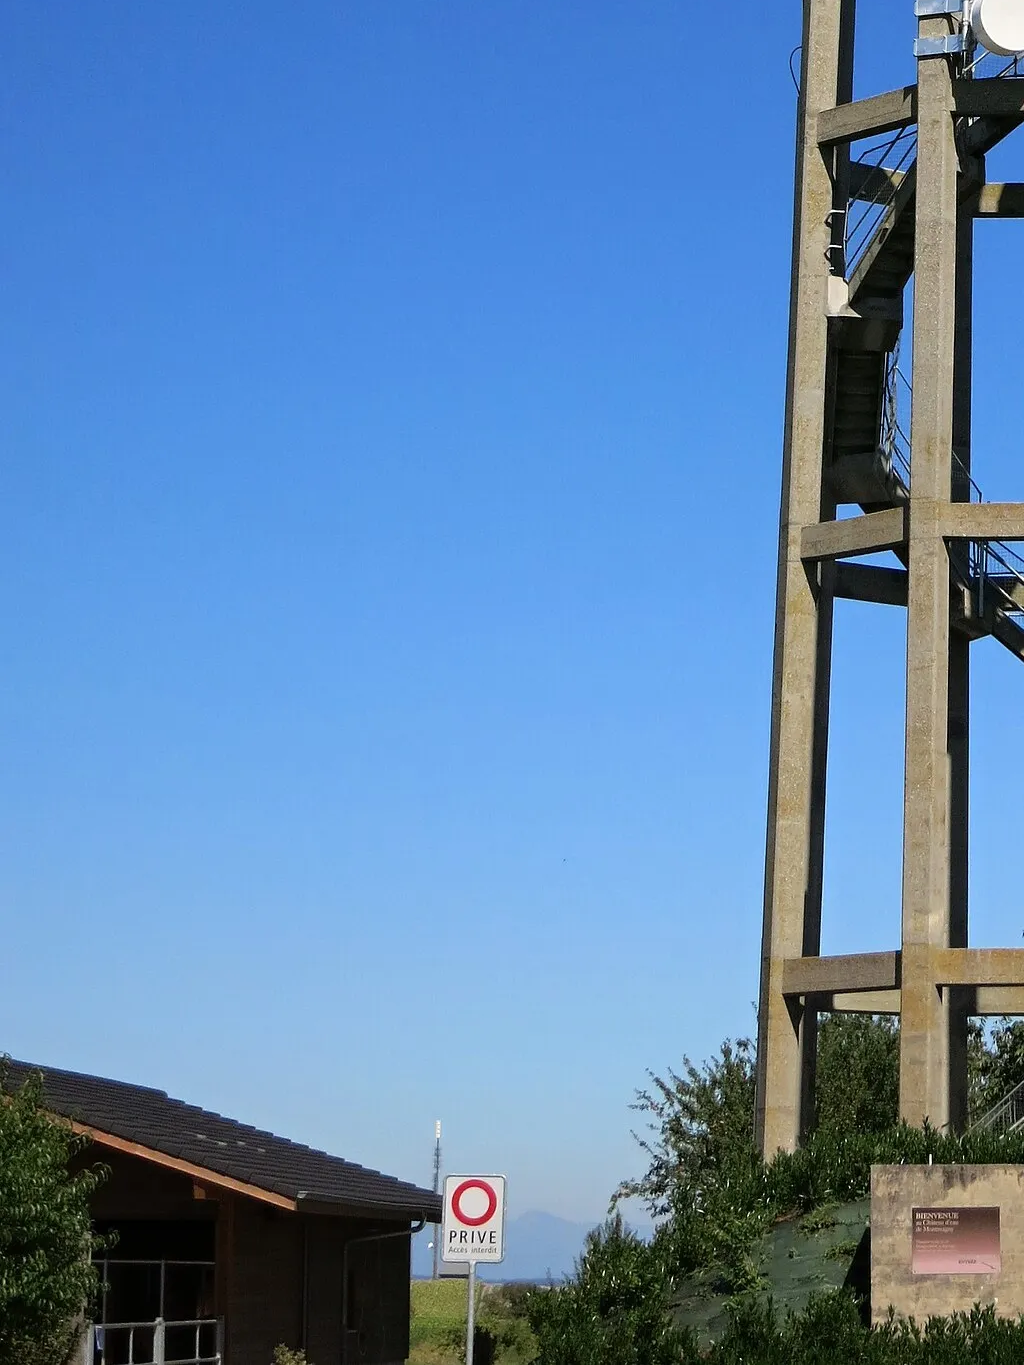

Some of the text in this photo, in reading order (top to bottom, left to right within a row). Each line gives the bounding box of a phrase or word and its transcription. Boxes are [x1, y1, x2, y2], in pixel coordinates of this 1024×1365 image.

[915, 1212, 959, 1220] BIENVENUE
[449, 1231, 496, 1243] PRIVE
[448, 1245, 497, 1254] Accès interdit
